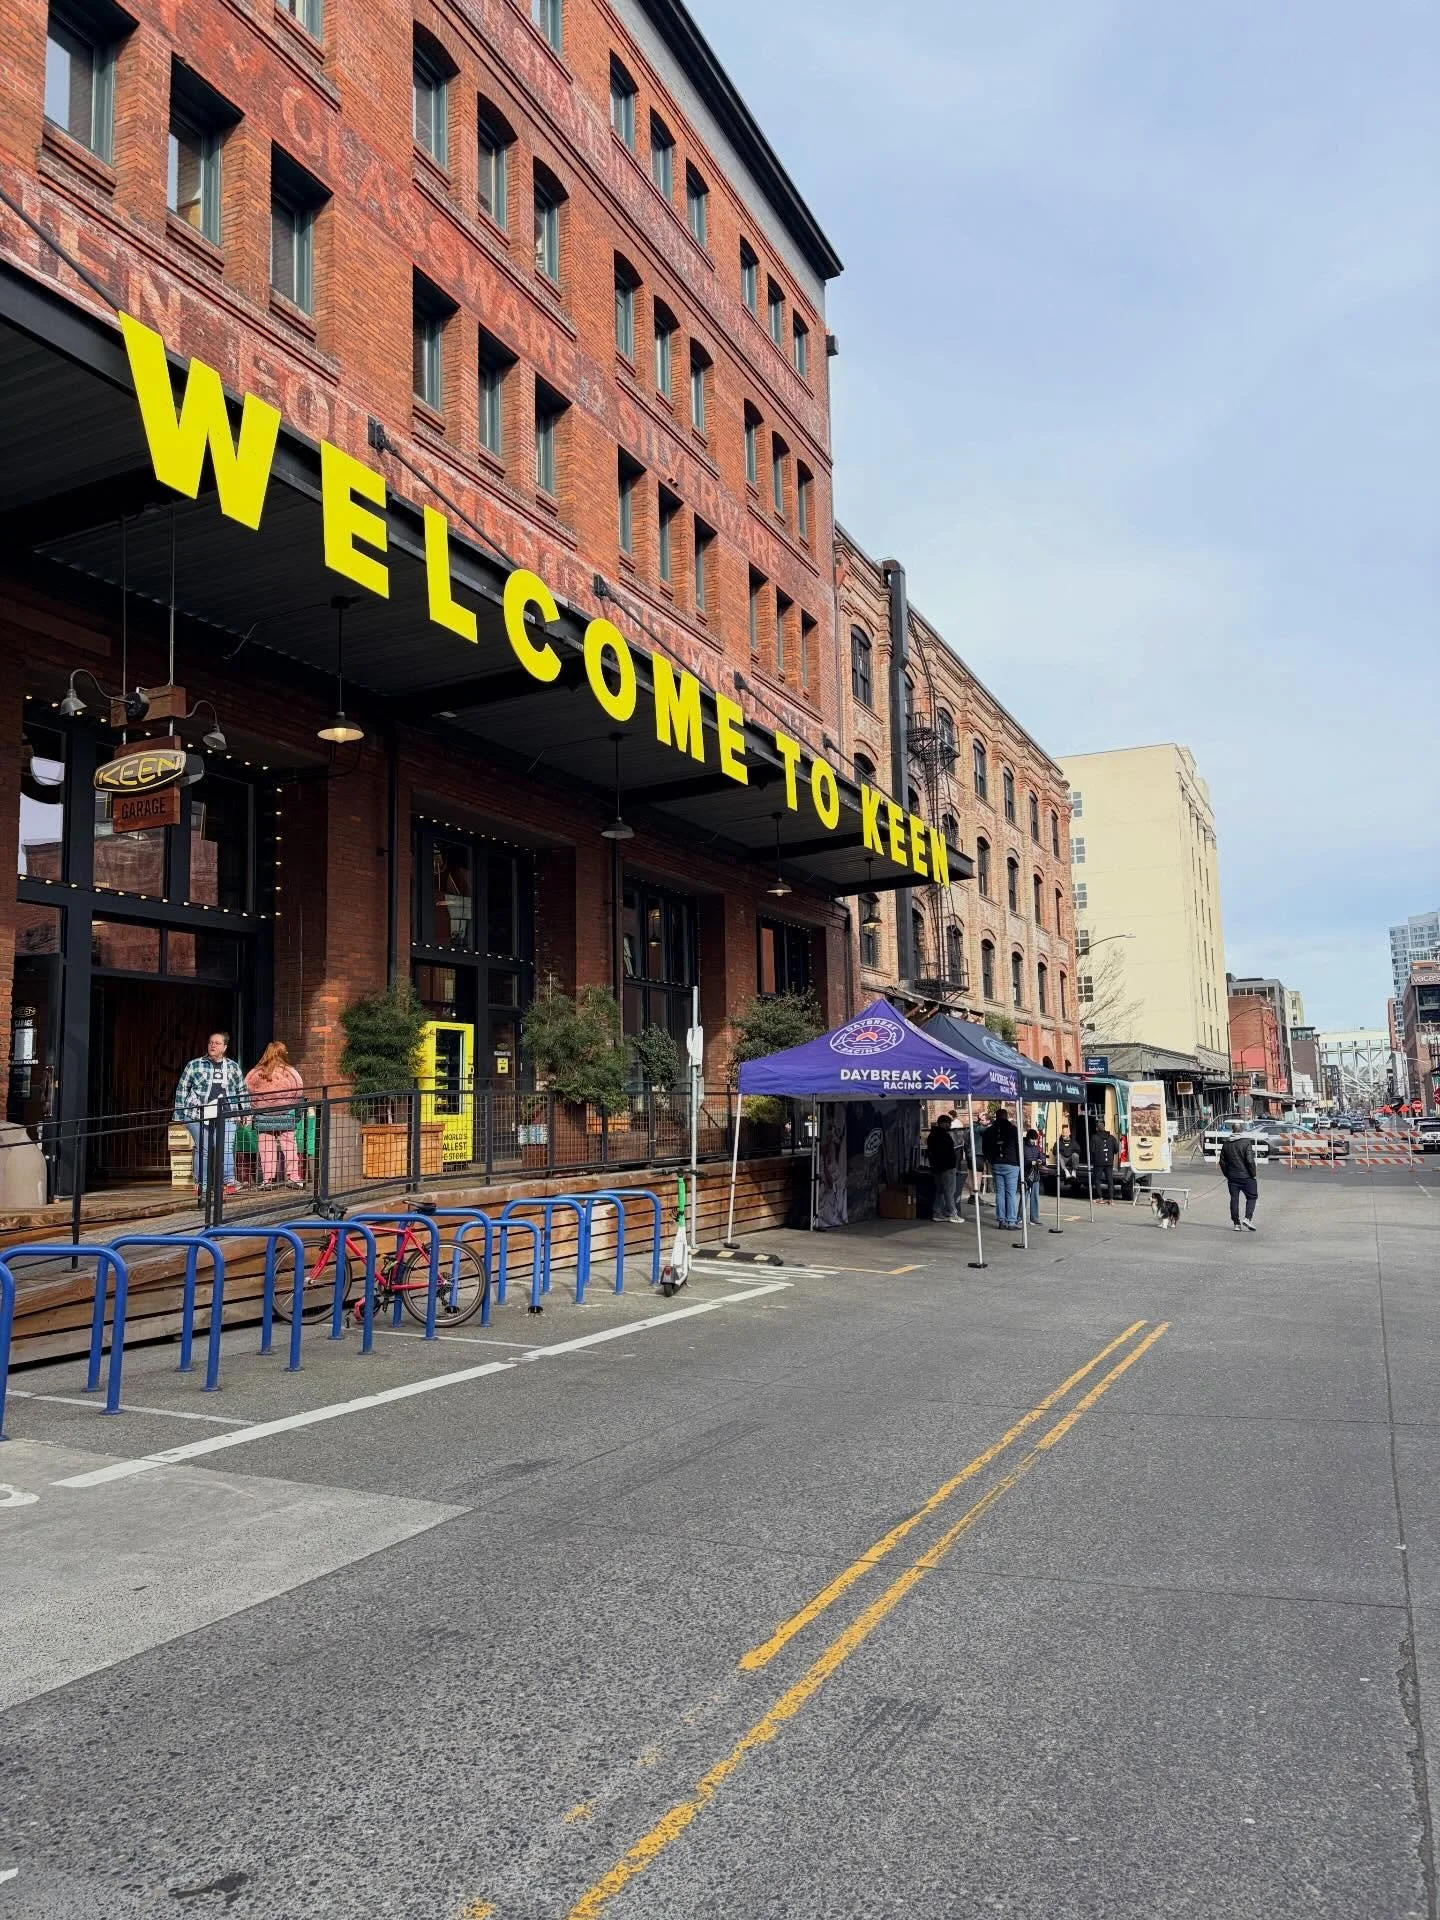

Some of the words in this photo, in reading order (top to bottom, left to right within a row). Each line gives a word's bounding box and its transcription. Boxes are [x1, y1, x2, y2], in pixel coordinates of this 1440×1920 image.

[119, 312, 747, 784] WELCOME
[775, 732, 839, 828] TO
[862, 784, 949, 888] KEEN
[98, 755, 181, 786] KEEN
[121, 796, 166, 820] GARAGE
[840, 1069, 922, 1081] DAYBREAK
[883, 1081, 922, 1090] RACING
[442, 1142, 467, 1152] ALLEST
